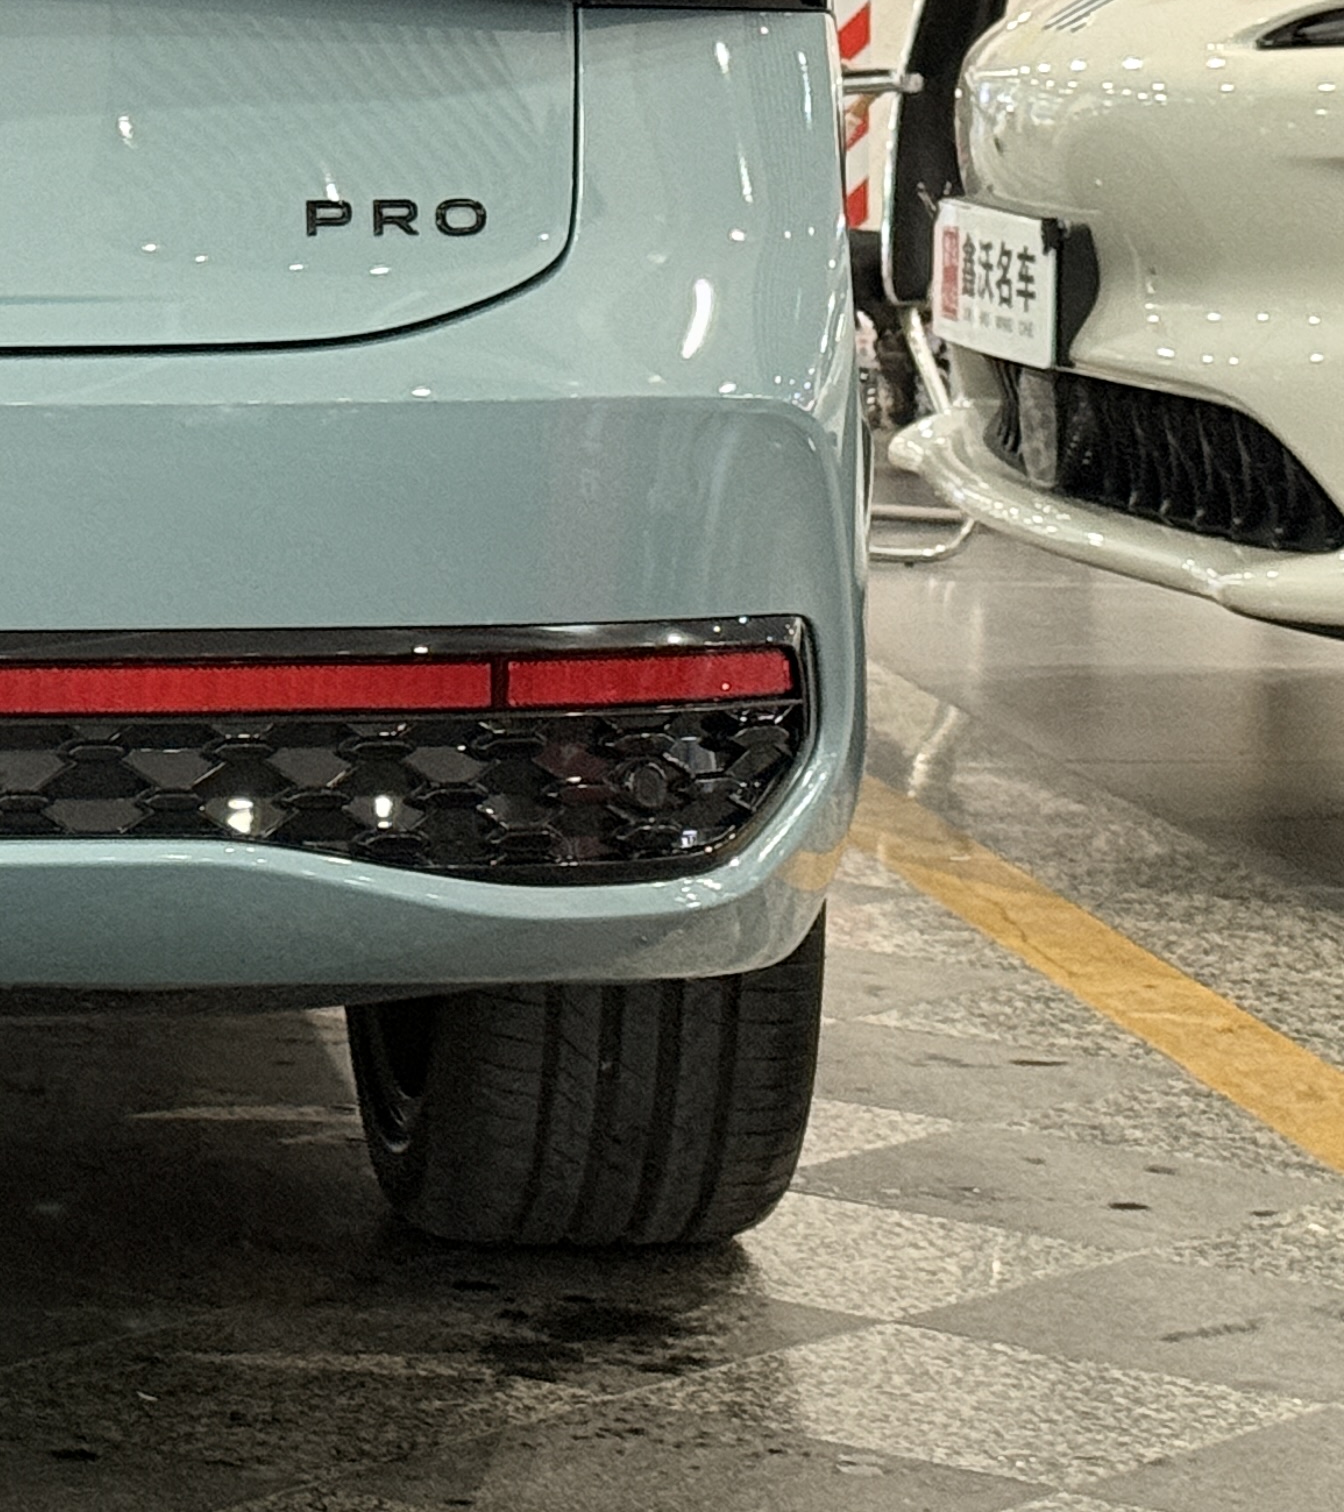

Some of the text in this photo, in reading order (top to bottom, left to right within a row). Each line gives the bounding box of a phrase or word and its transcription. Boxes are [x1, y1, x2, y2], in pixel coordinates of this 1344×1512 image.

[306, 198, 487, 237] PRO
[962, 232, 1037, 313] 鑫沃名车
